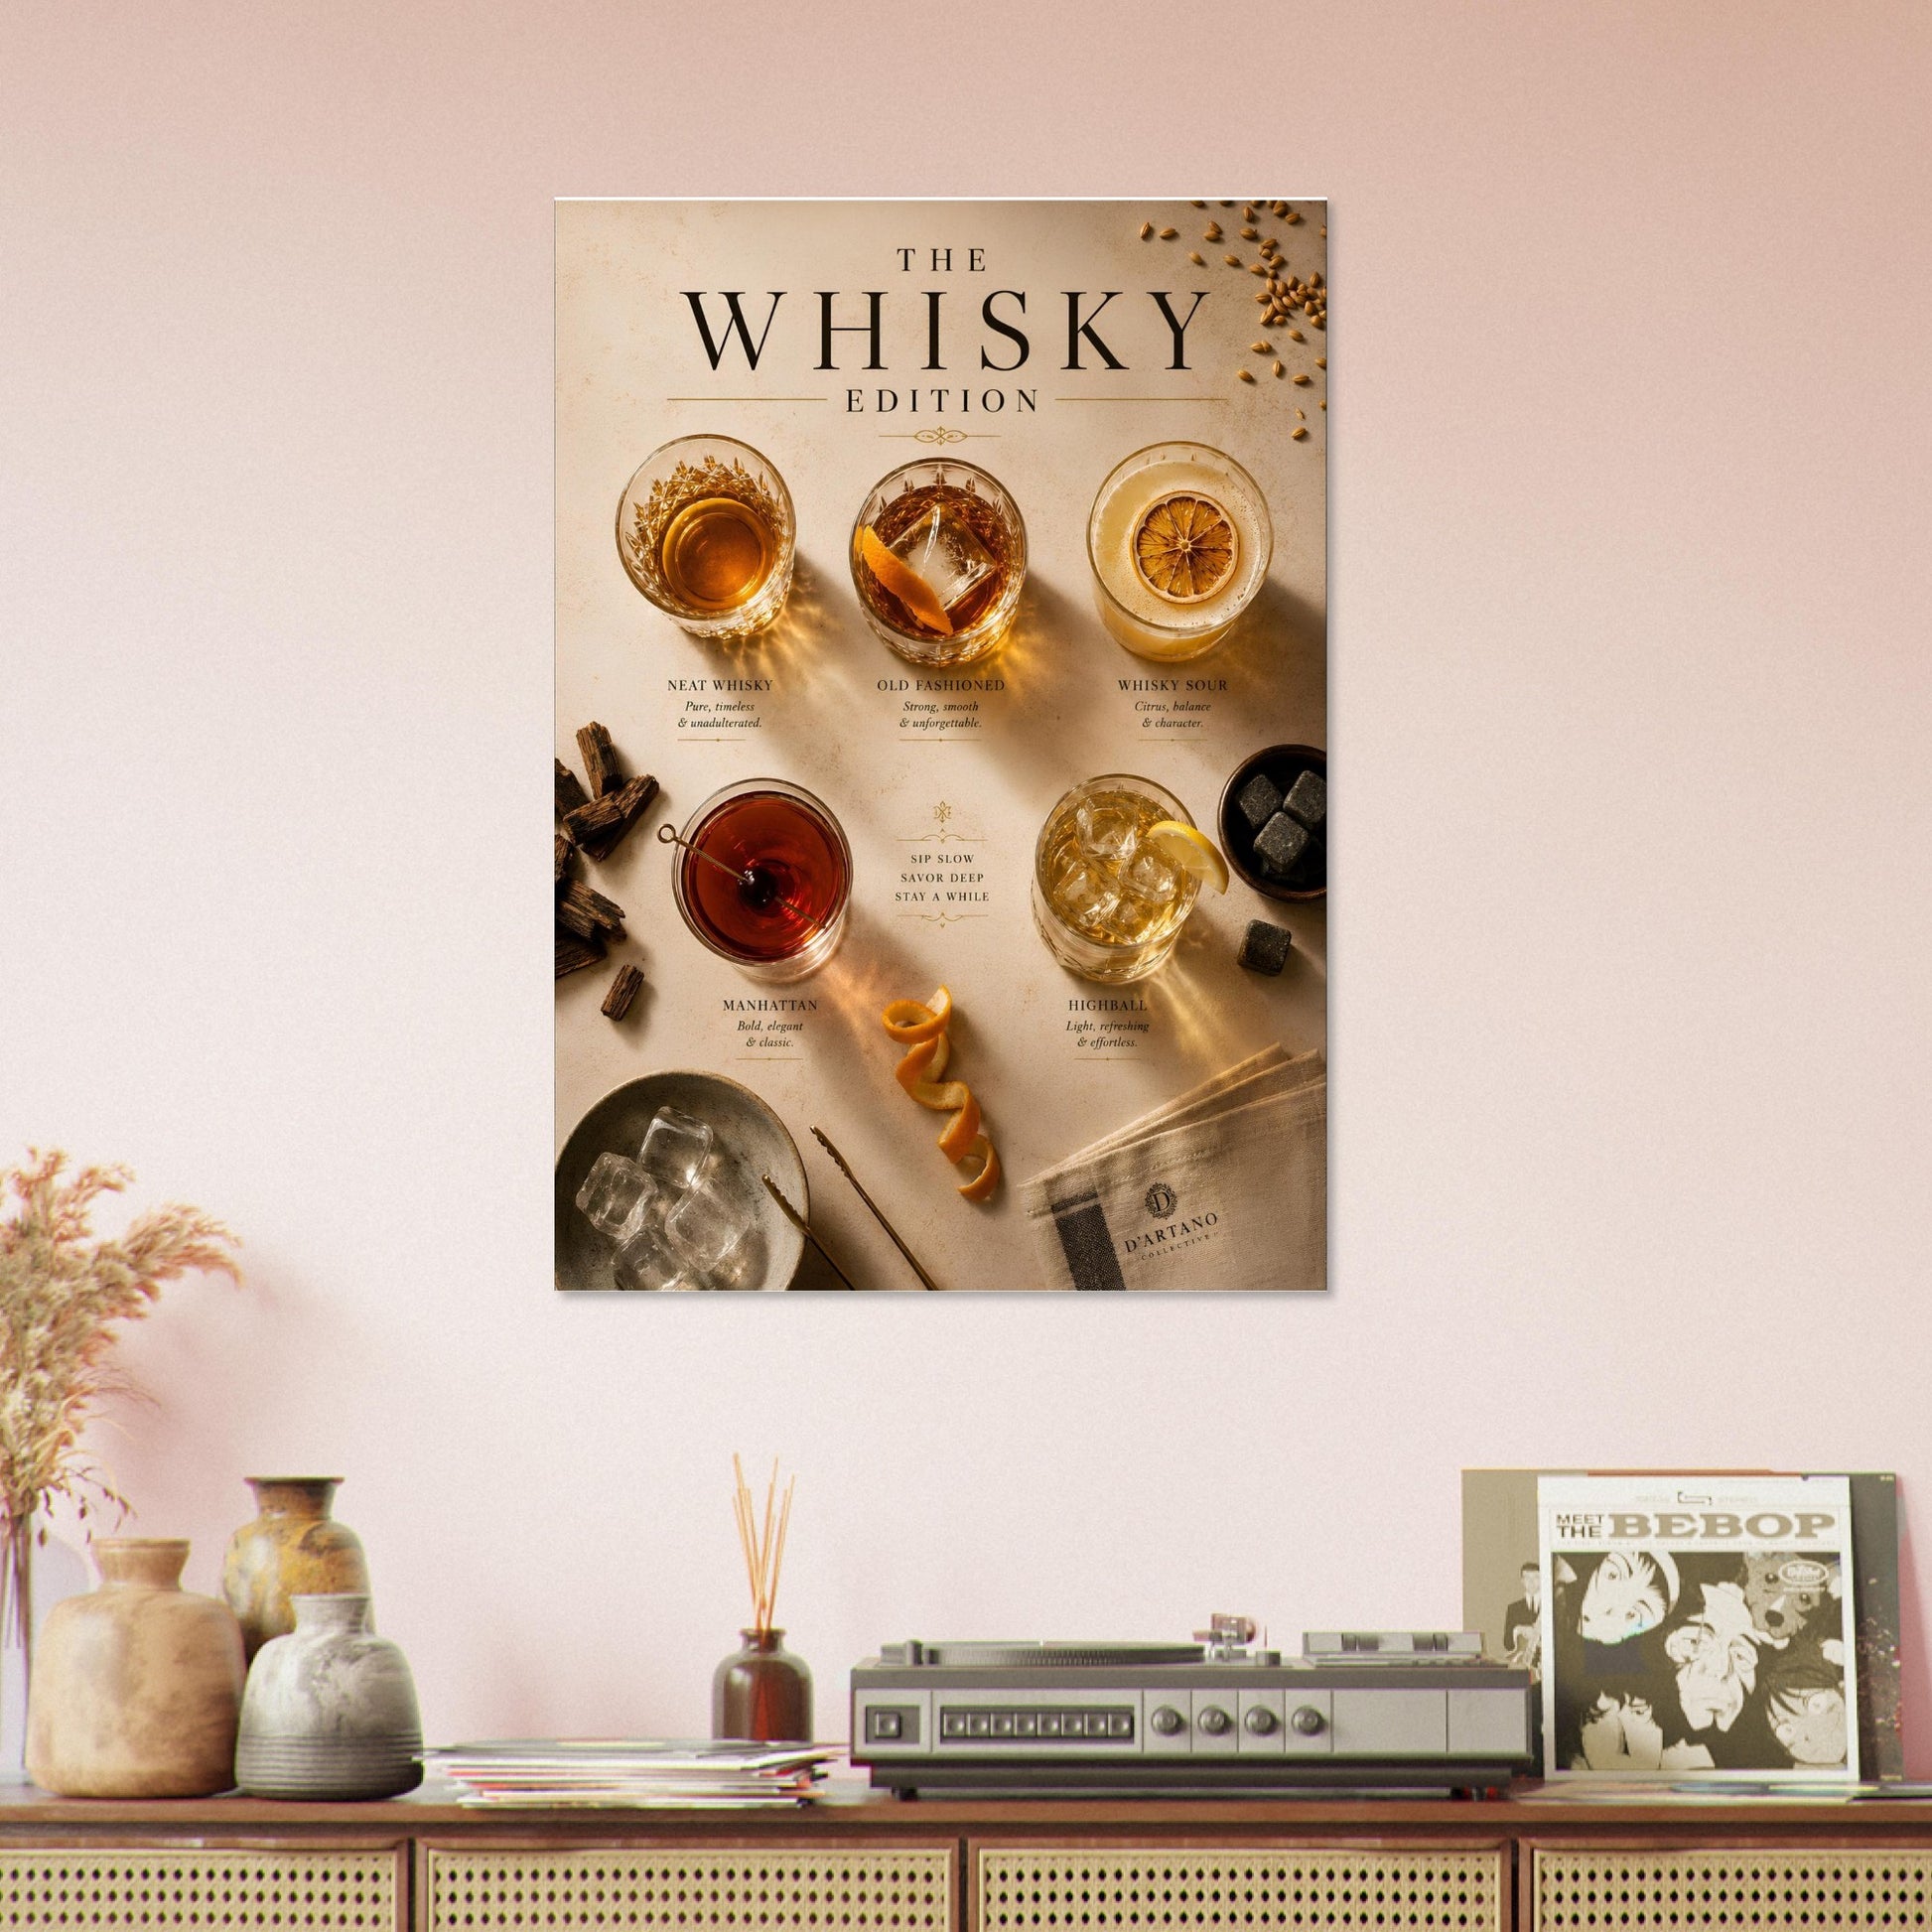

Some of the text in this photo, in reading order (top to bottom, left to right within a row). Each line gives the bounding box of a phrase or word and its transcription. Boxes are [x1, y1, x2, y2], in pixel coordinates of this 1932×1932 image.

[897, 248, 987, 272] THE
[680, 291, 1210, 371] WHISKY
[847, 388, 1038, 413] EDITION
[667, 680, 772, 691] NEAT WHISKY
[877, 680, 1005, 691] OLD FASHIONED
[1118, 680, 1227, 691] WHISKY SOUR
[685, 701, 755, 713] Pure, timeless
[902, 701, 979, 714] Strong, smooth
[1135, 701, 1211, 712] Citrus, balance
[678, 718, 761, 729] & unadulterated.
[899, 718, 982, 731] & unforgettable.
[1142, 718, 1203, 729] & character.
[911, 855, 974, 864] SIP SLOW
[900, 874, 984, 883] SAVOR DEEP
[896, 893, 989, 901] STAY A WHILE
[724, 1000, 817, 1011] MANHATTAN
[1069, 1000, 1147, 1011] HIGHBALL
[738, 1021, 803, 1033] Bold, elegant
[1066, 1021, 1150, 1034] Light, refreshing
[747, 1037, 794, 1047] & classic.
[1078, 1036, 1138, 1049] & effortless.
[1125, 1213, 1217, 1253] D'ARTANO
[1142, 1235, 1209, 1260] COLLECTIVE
[1557, 1514, 1604, 1525] MEET
[1608, 1513, 1835, 1538] BEBOP
[1557, 1526, 1601, 1538] THE
